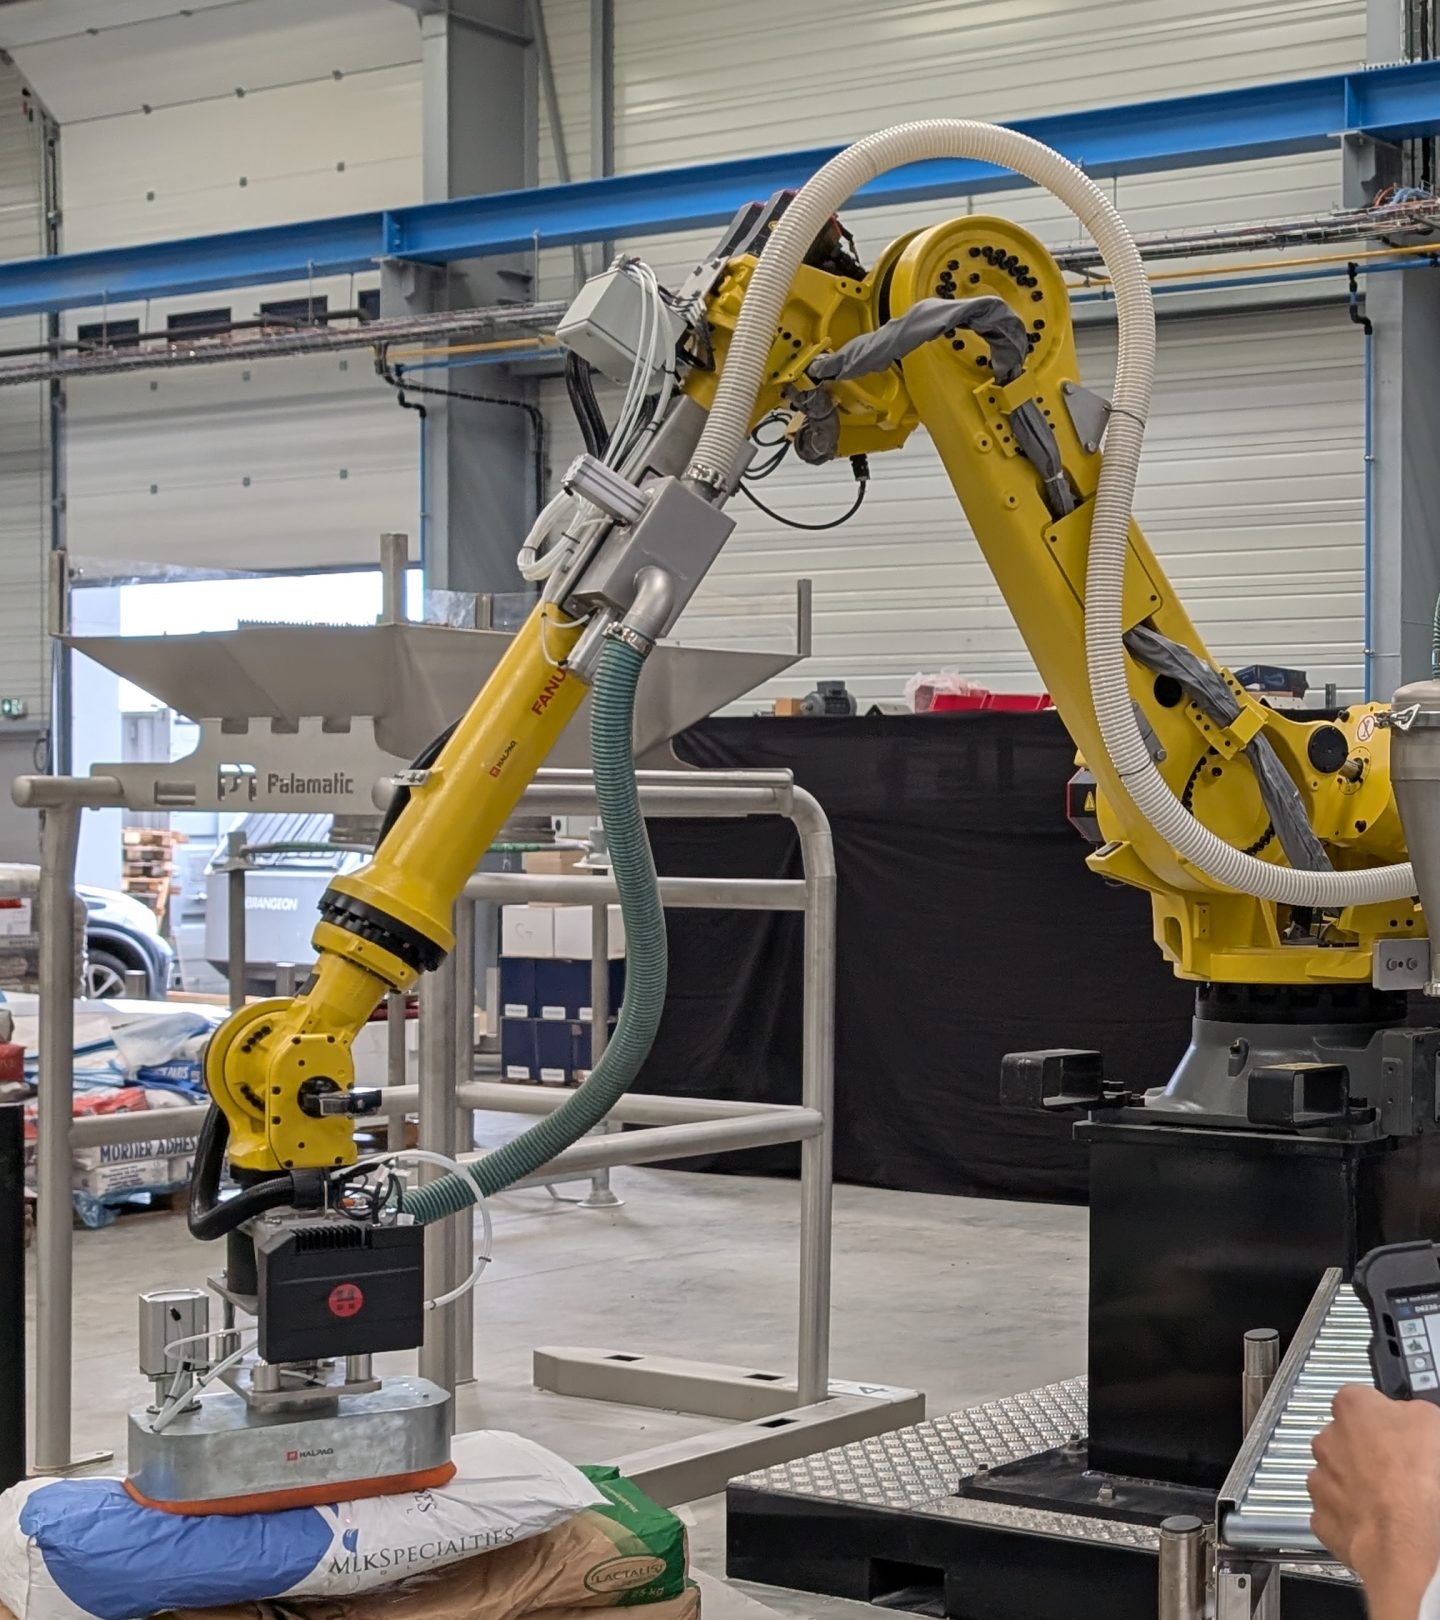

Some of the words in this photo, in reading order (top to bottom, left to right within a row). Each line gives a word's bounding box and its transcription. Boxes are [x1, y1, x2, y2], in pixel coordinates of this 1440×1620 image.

[531, 667, 568, 716] FANU
[267, 772, 354, 794] Palamatic
[156, 1135, 198, 1157] ADHES
[595, 1565, 661, 1584] LACTALIS
